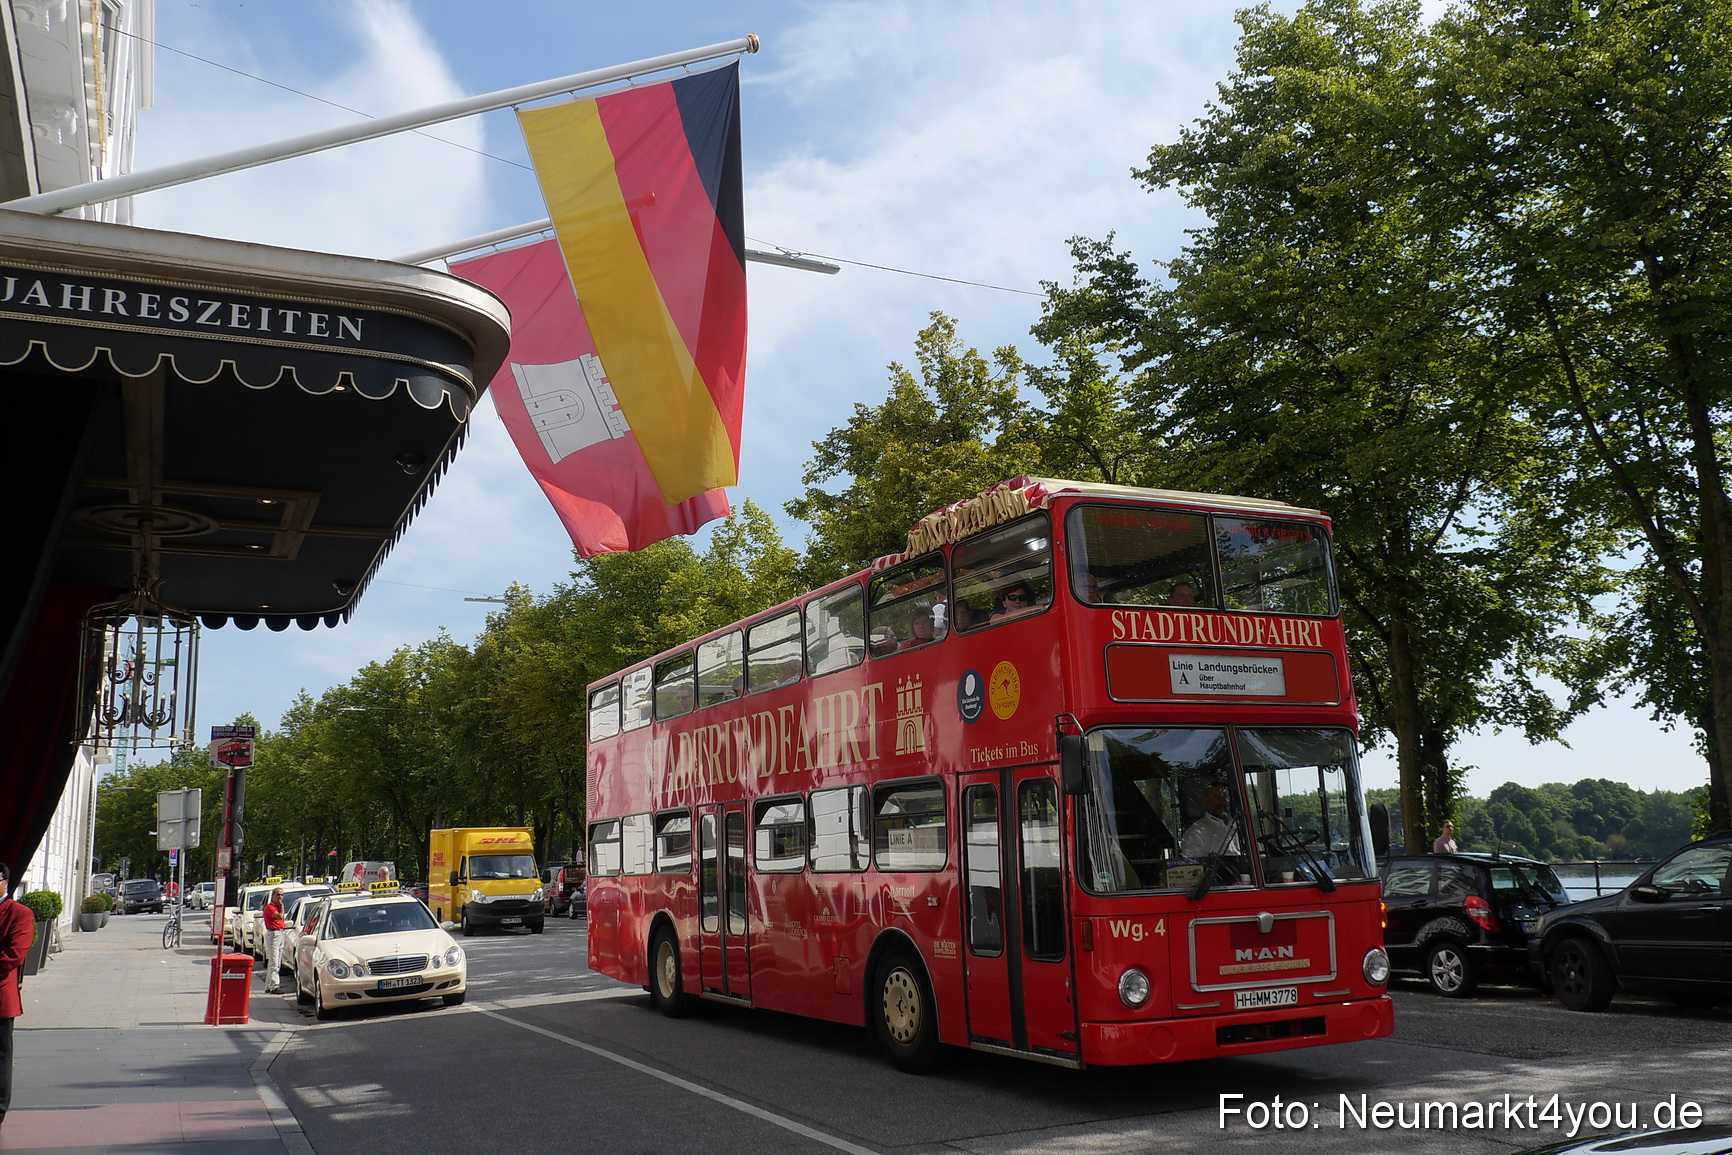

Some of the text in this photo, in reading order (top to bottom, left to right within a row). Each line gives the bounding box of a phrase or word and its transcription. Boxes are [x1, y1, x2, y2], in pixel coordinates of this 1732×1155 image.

[1, 276, 364, 342] JAHRESZEITEN
[1110, 609, 1324, 647] STADTRUNDFAHRT
[1172, 660, 1279, 675] Linie Landungsbrücken
[1179, 671, 1215, 685] A über
[1200, 682, 1246, 691] Hauptbahnhof
[643, 681, 884, 797] STADTRUNDFAHRT
[970, 740, 1039, 764] Tickets im Bus
[481, 837, 519, 845] DHL
[907, 832, 913, 845] A
[370, 881, 398, 890] TAXI
[1109, 918, 1166, 941] Wg. 4
